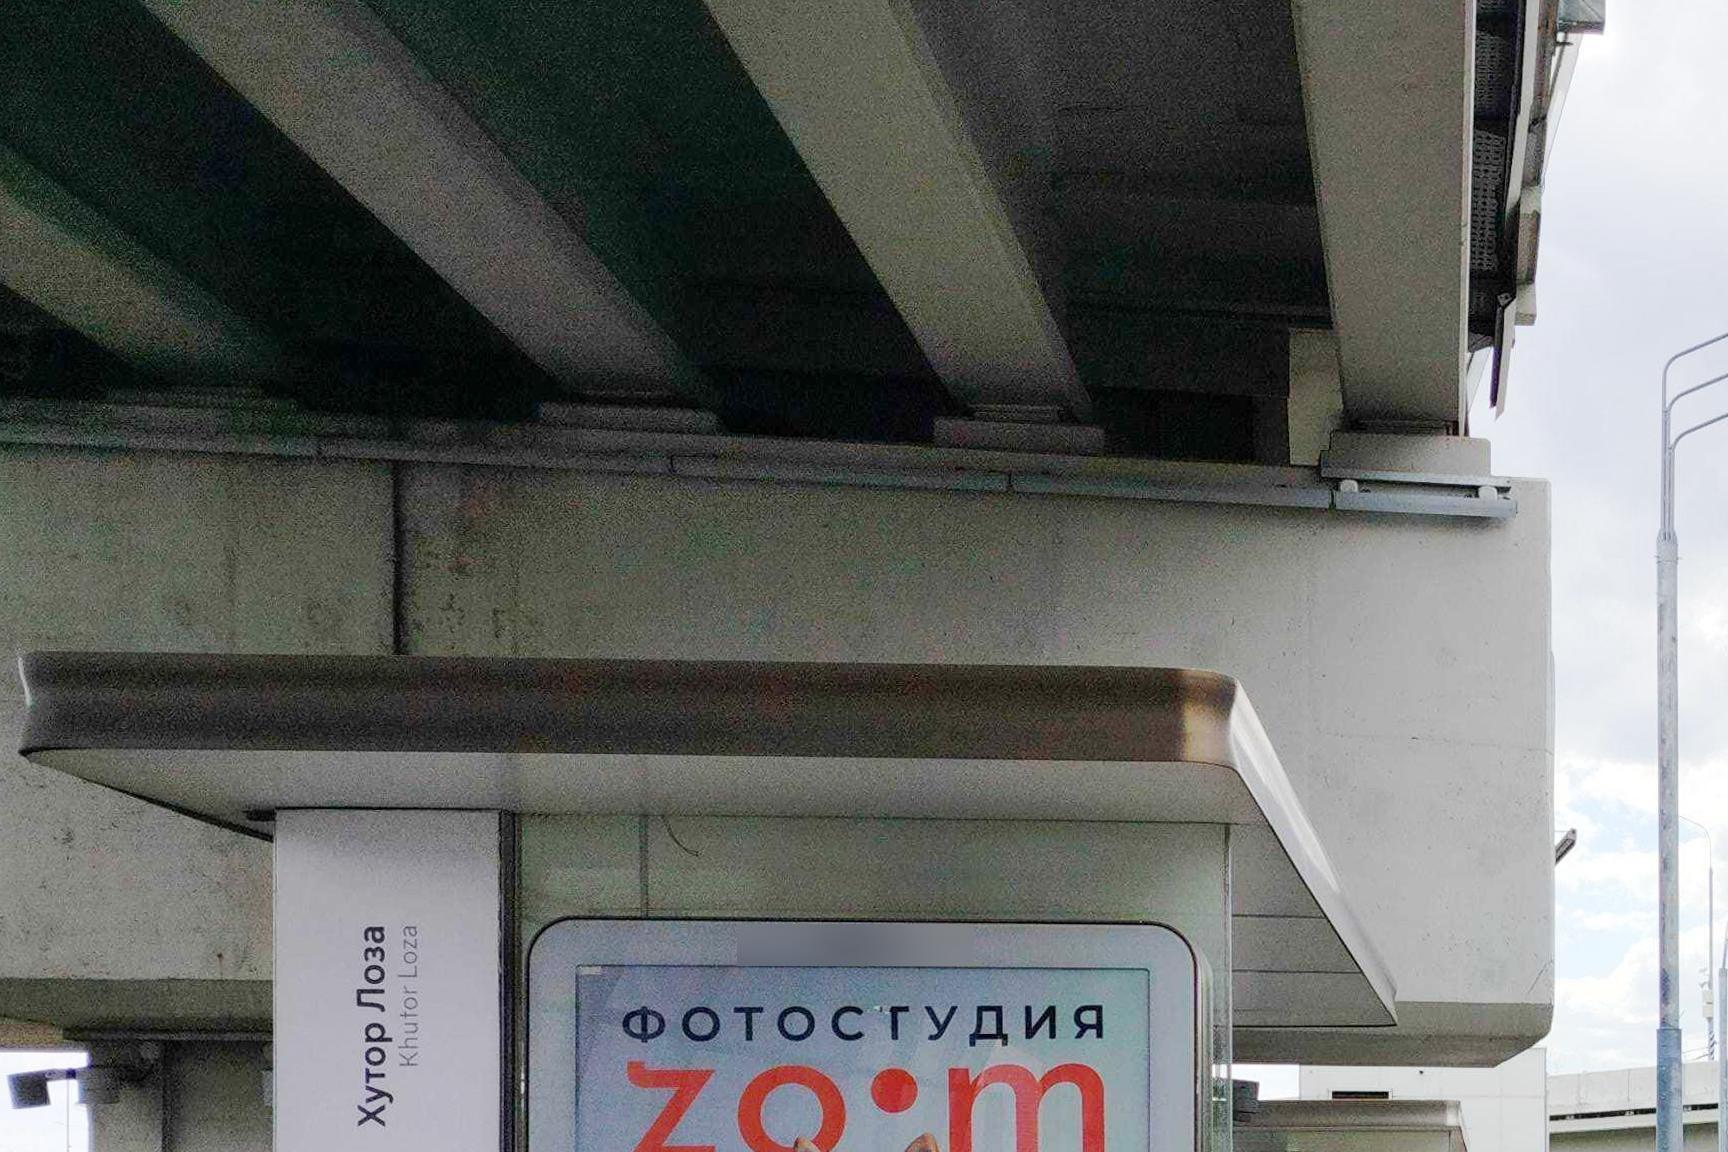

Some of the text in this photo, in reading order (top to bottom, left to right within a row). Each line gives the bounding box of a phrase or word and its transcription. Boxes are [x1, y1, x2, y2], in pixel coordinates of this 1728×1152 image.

[355, 925, 395, 1128] Хутор Лоза
[396, 925, 419, 1067] Khutor Loza
[621, 1004, 1105, 1048] ФОТОСТУДИЯ
